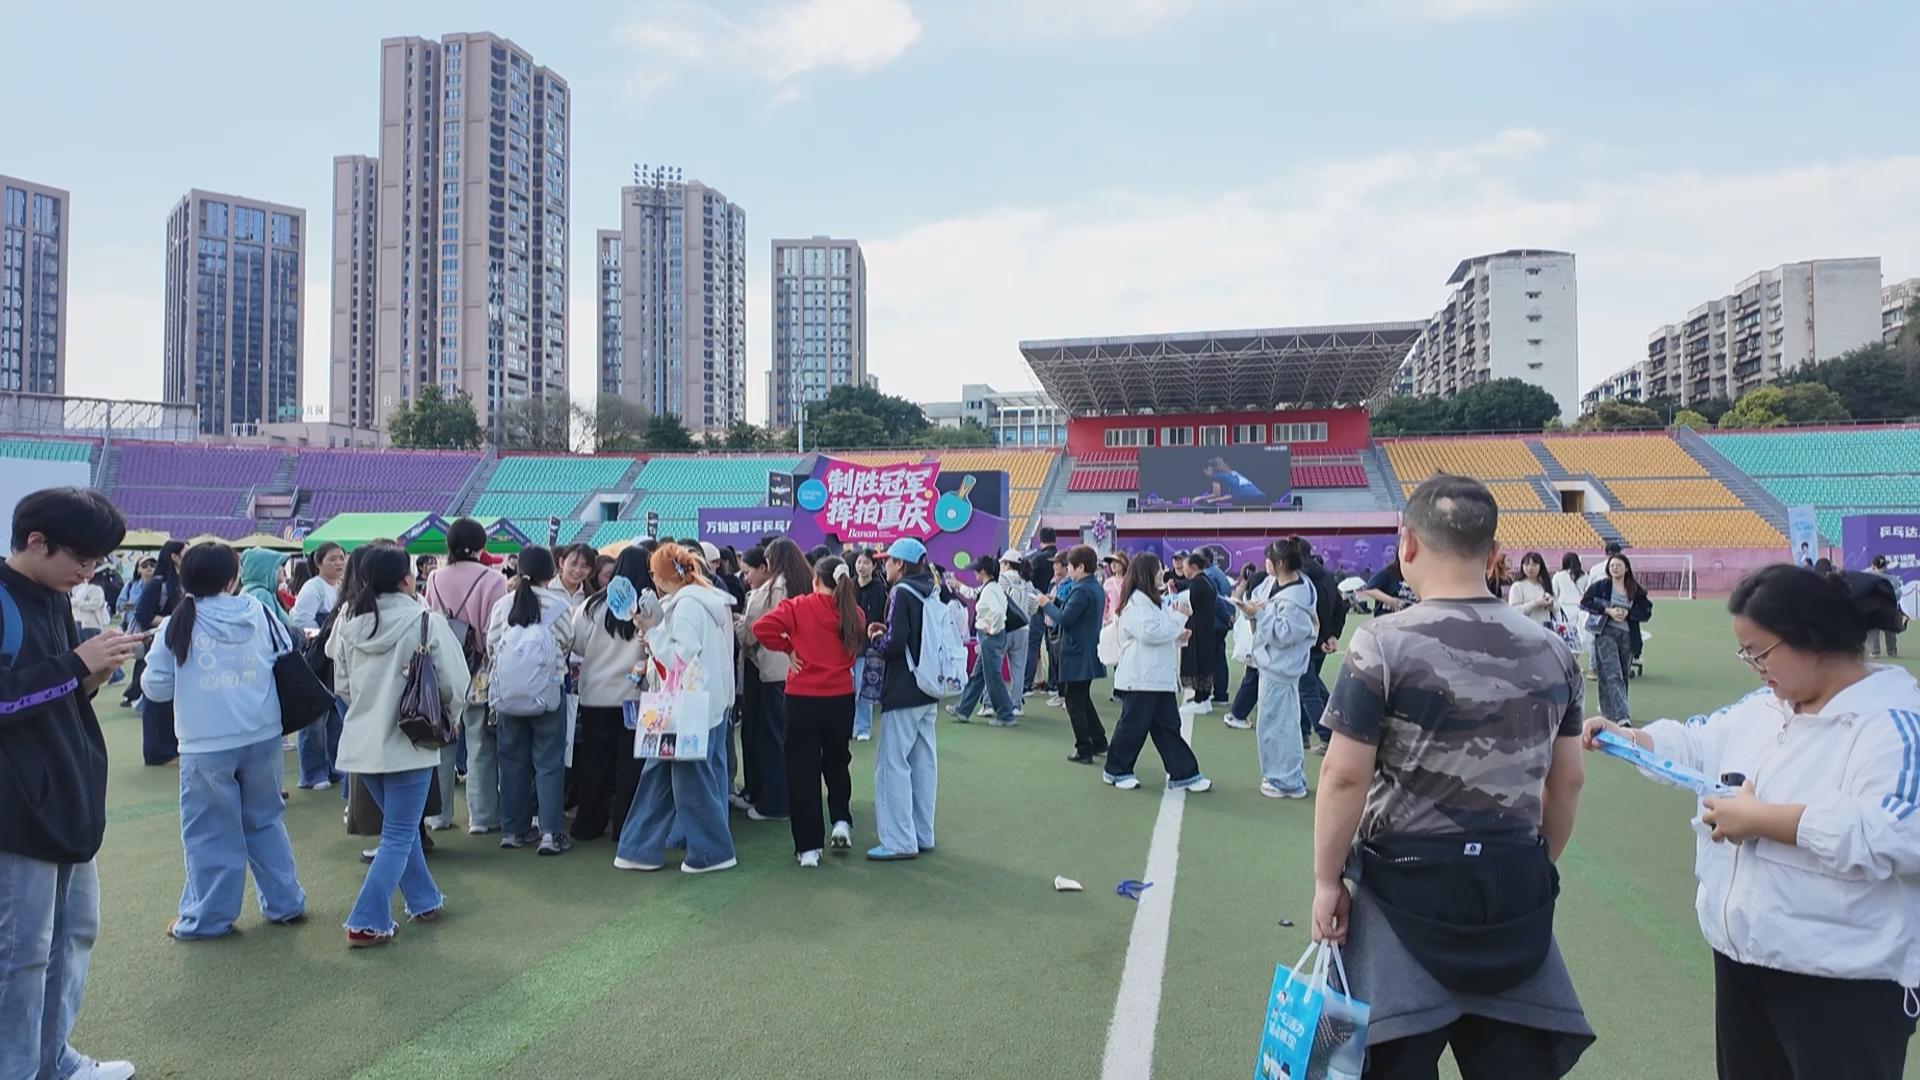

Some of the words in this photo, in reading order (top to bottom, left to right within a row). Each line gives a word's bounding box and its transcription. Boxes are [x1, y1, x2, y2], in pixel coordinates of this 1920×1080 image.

[827, 467, 933, 500] 制胜冠军
[825, 496, 932, 534] 挥拍重庆
[848, 528, 878, 539] Banan
[1880, 526, 1920, 539] 乒乓达
